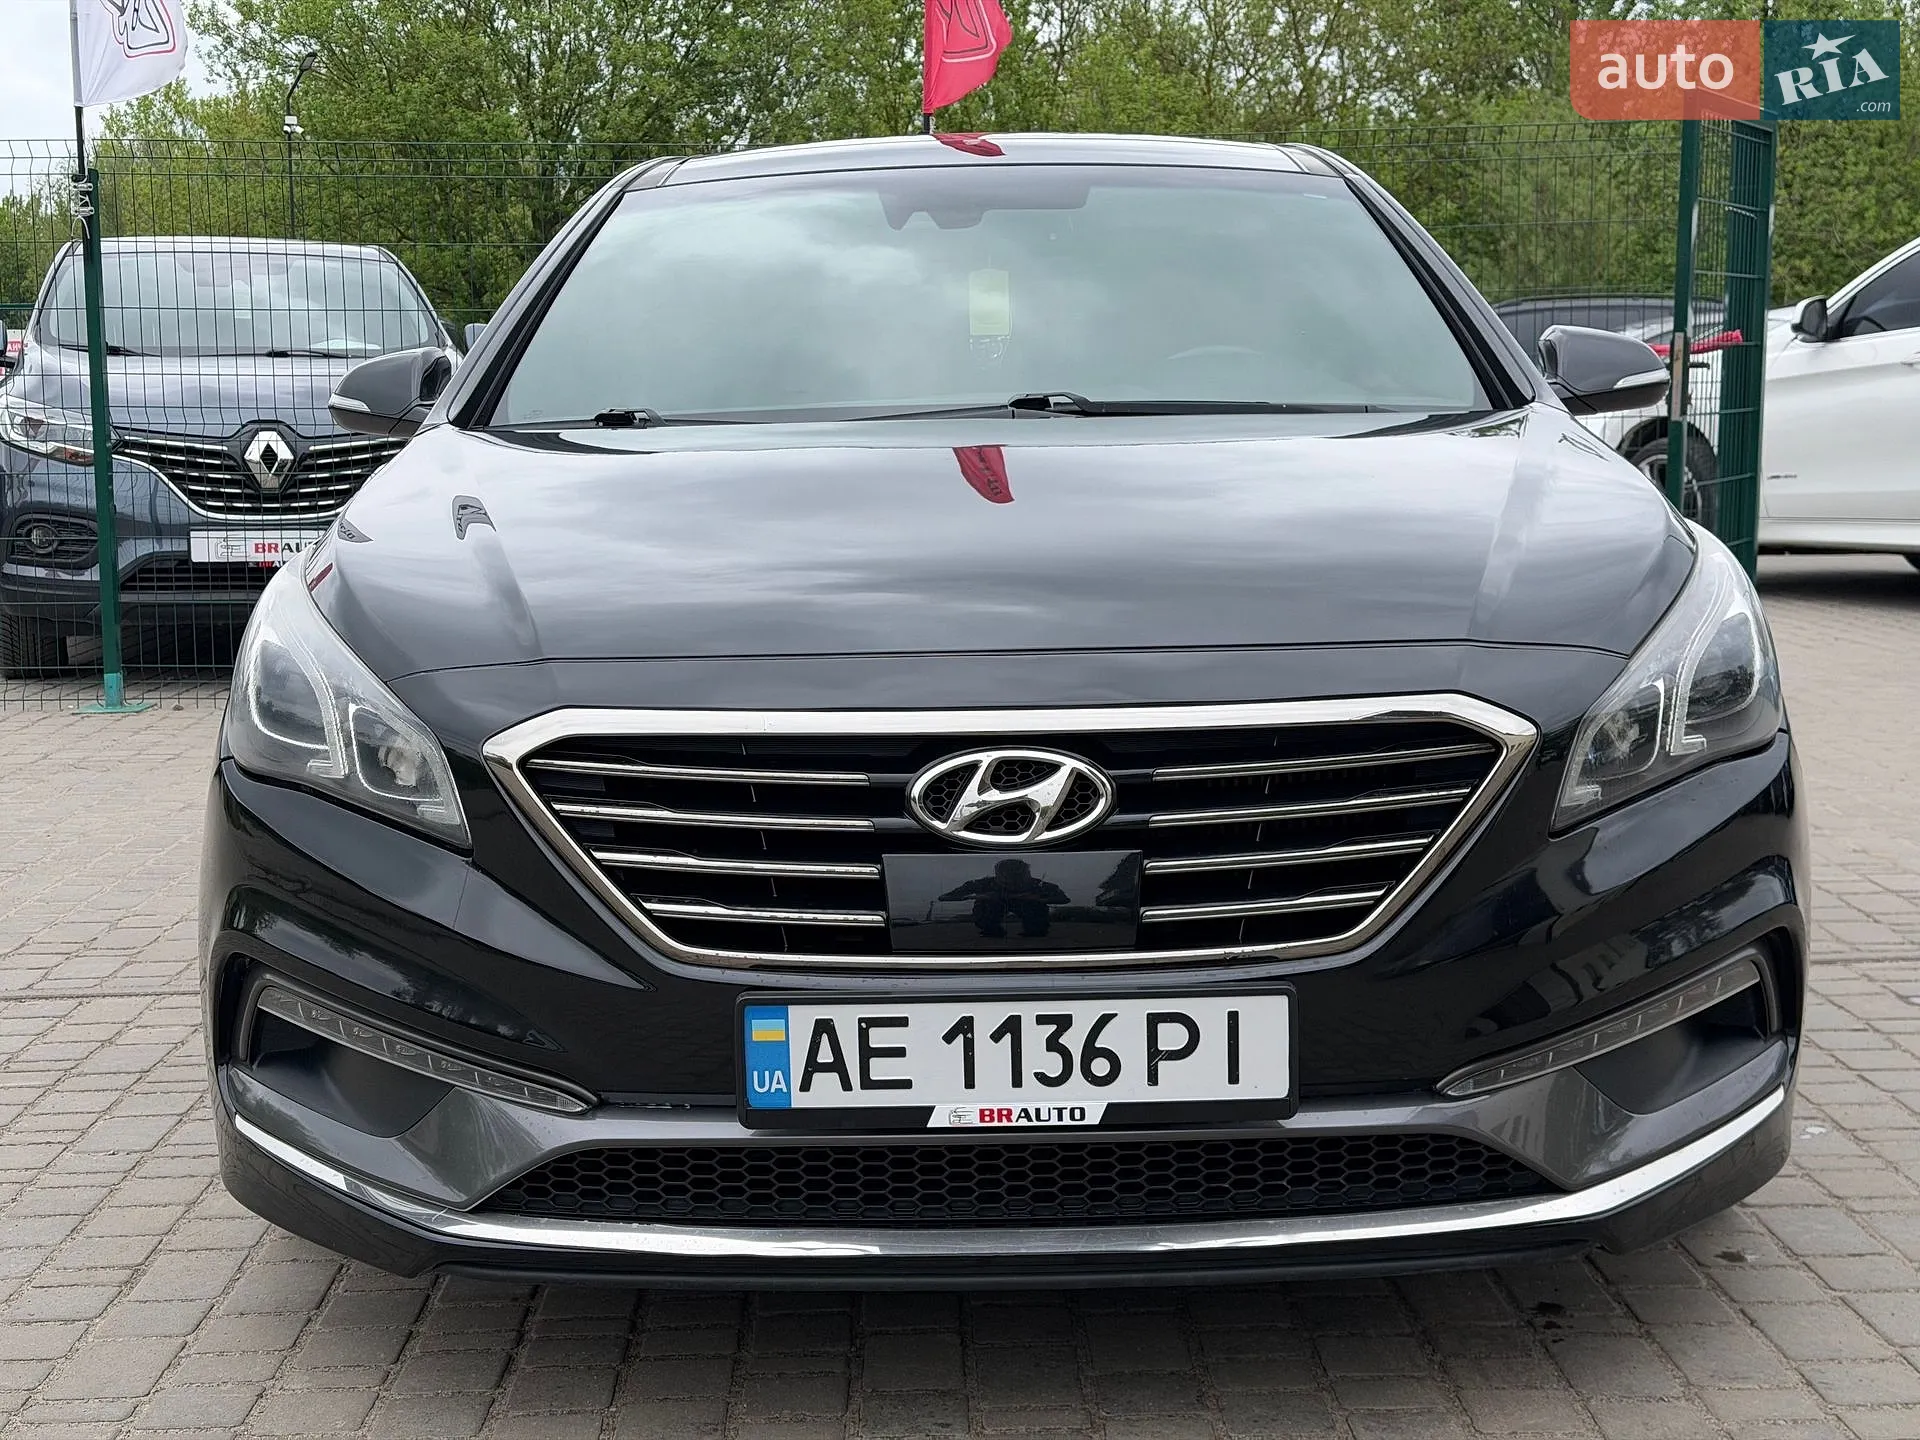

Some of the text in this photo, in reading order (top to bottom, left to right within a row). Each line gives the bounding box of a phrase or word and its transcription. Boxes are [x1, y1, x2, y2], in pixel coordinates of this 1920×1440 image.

[254, 542, 313, 554] BRAU
[798, 1016, 913, 1092] AE
[941, 1012, 1122, 1090] 1136
[753, 1070, 787, 1093] UA
[979, 1106, 1086, 1124] BRAUTO
